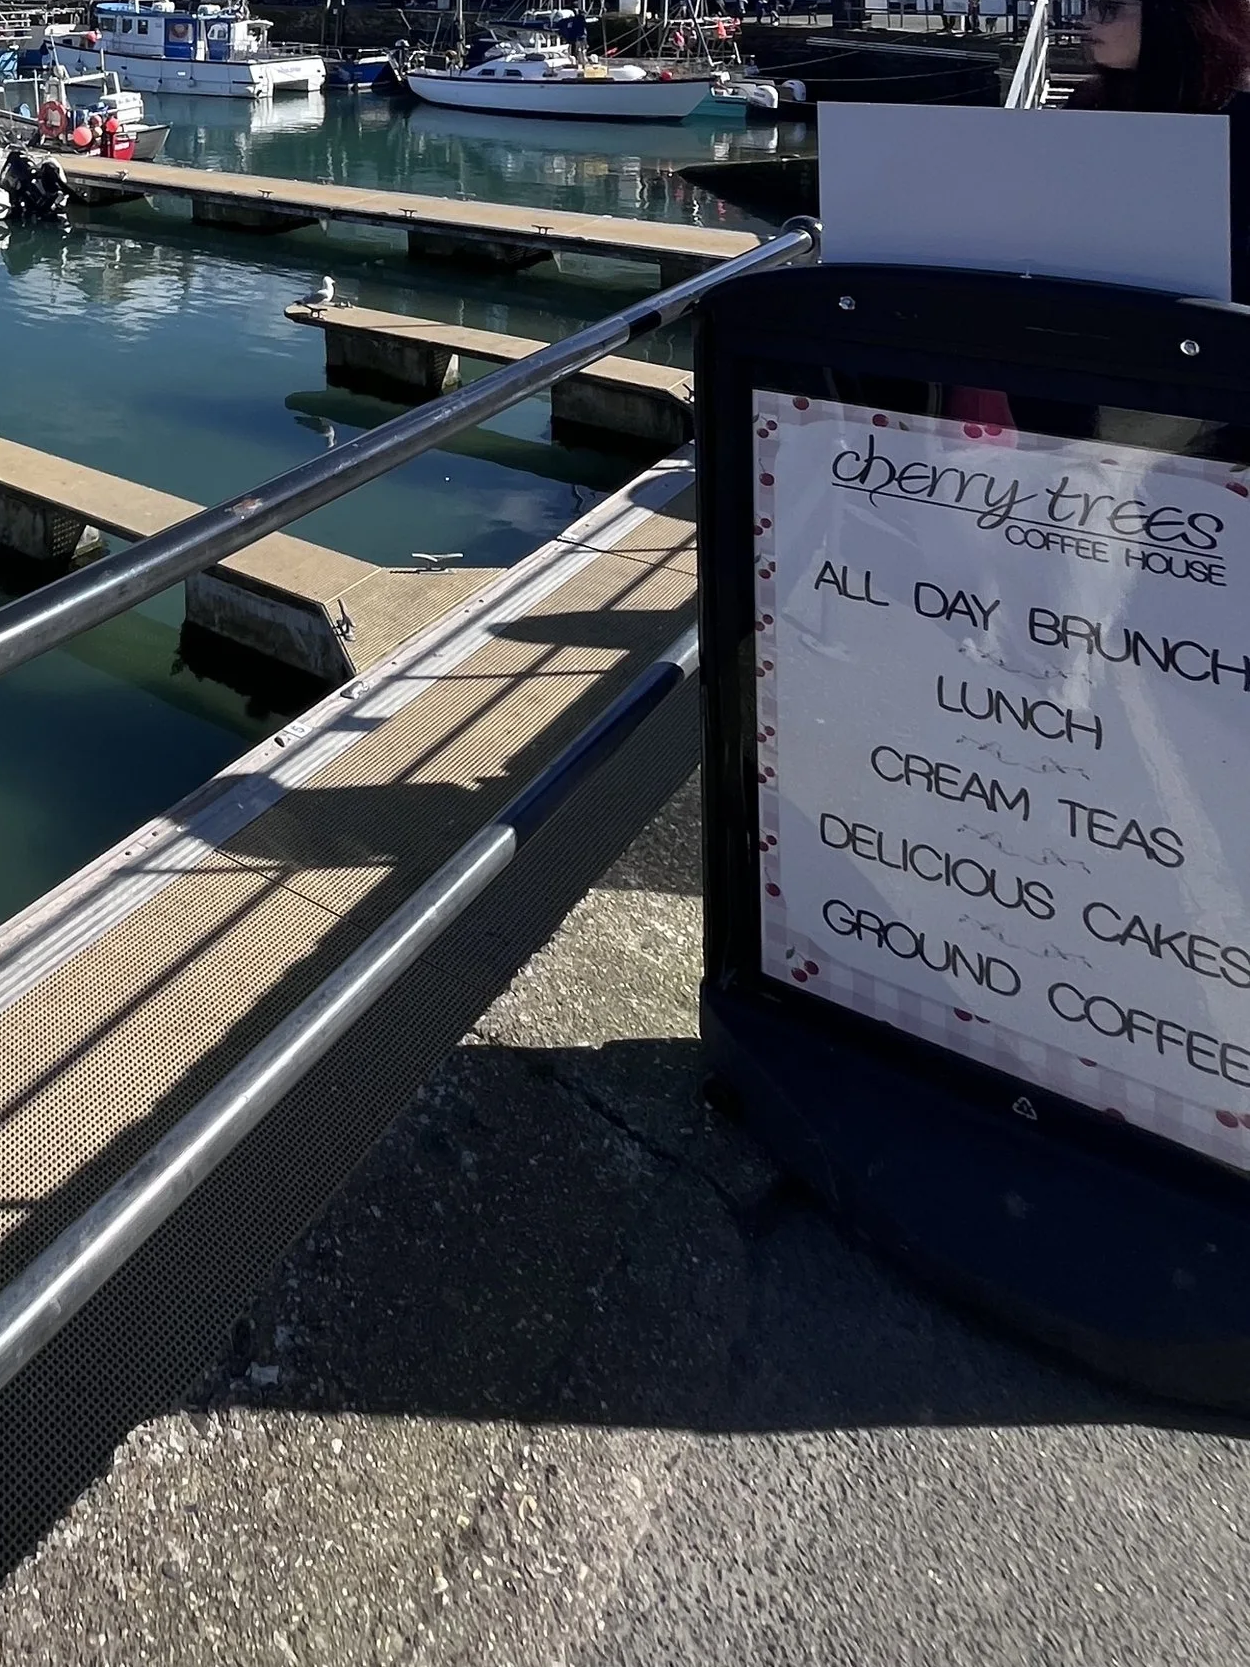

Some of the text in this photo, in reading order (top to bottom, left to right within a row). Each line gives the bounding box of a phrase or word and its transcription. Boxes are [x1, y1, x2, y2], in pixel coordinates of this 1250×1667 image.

[832, 434, 1223, 550] cherry trees
[1005, 525, 1227, 587] COFFEE HOUSE
[814, 560, 1250, 693] ALL DAY BRUNCH
[937, 675, 1102, 750] LUNCH
[871, 745, 1185, 868] CREAM TEAS
[820, 812, 1250, 989] DELICIOUS CAKES
[822, 899, 1250, 1087] GROUND COFFEE
